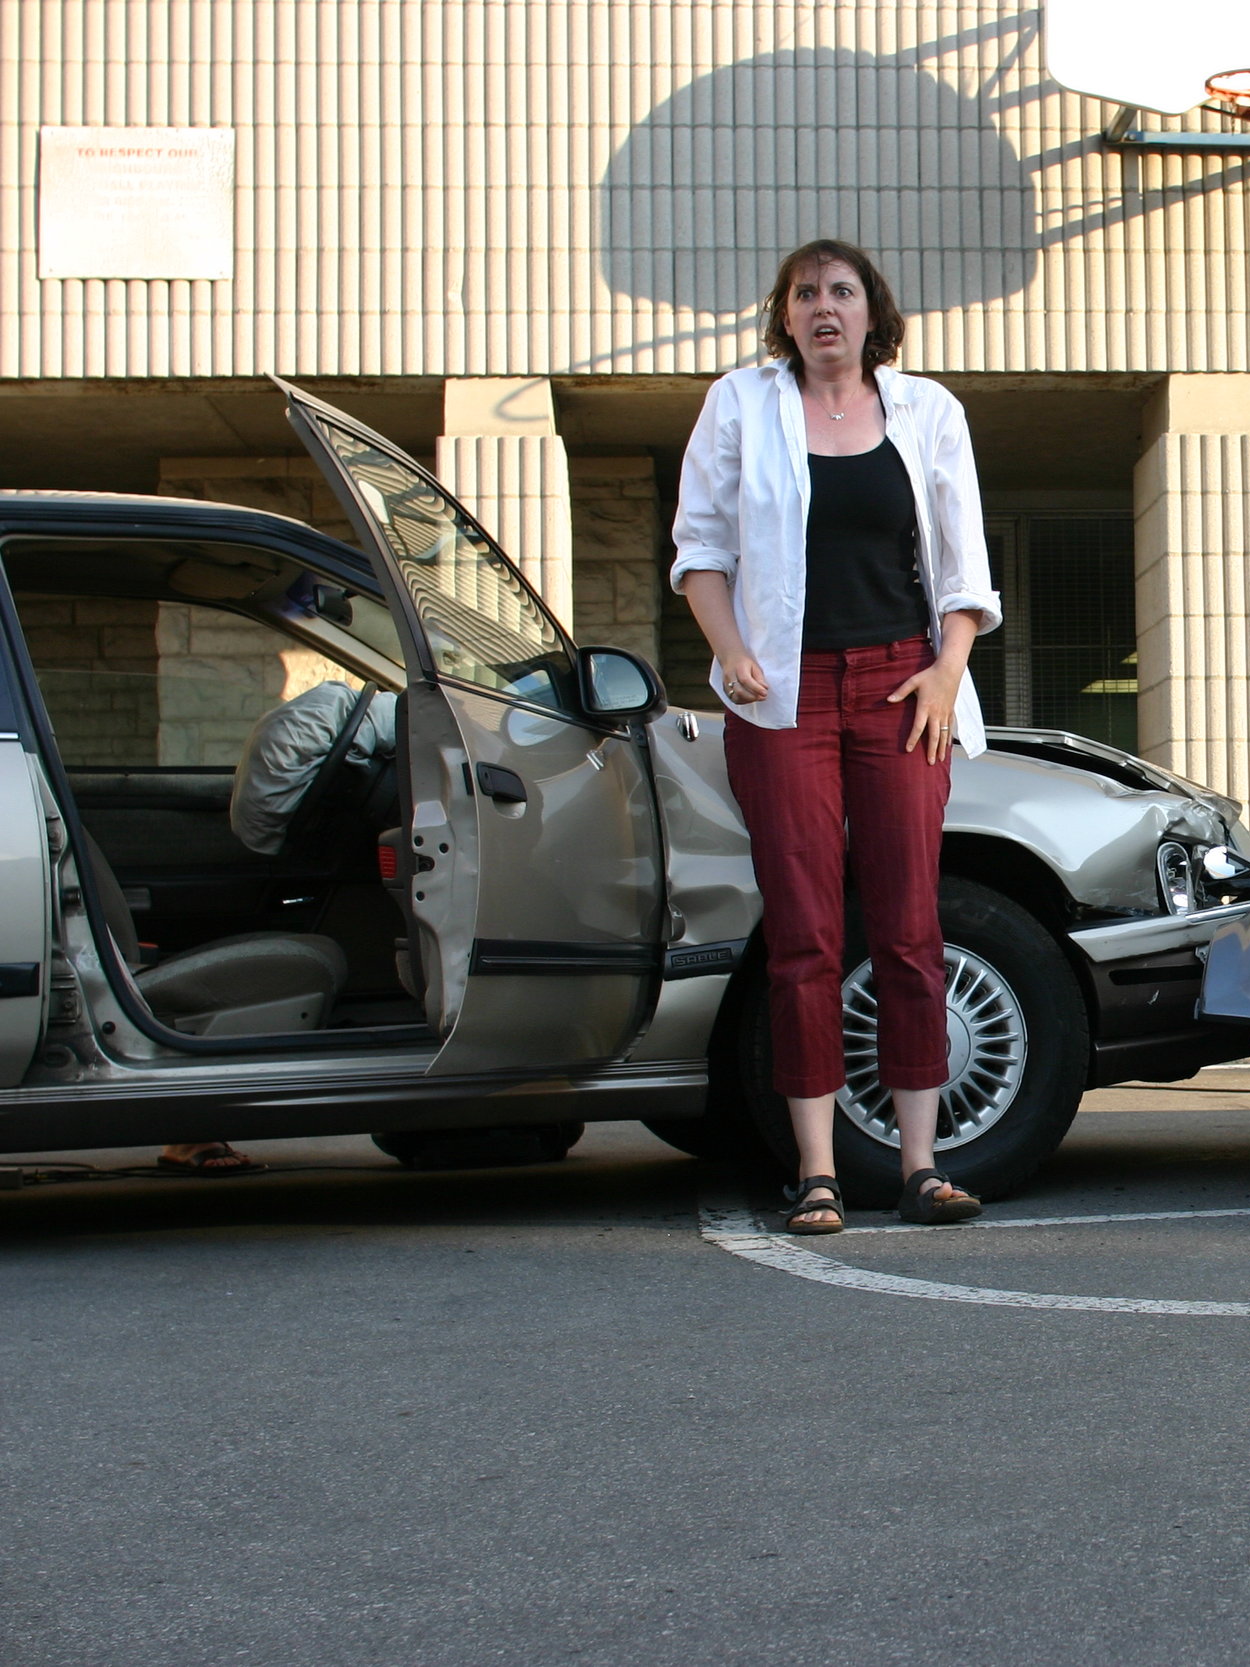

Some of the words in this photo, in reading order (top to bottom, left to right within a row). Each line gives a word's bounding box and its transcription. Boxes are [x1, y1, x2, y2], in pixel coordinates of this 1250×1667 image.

[77, 147, 95, 158] TO
[99, 147, 163, 158] RESPECT
[167, 148, 198, 158] OUR
